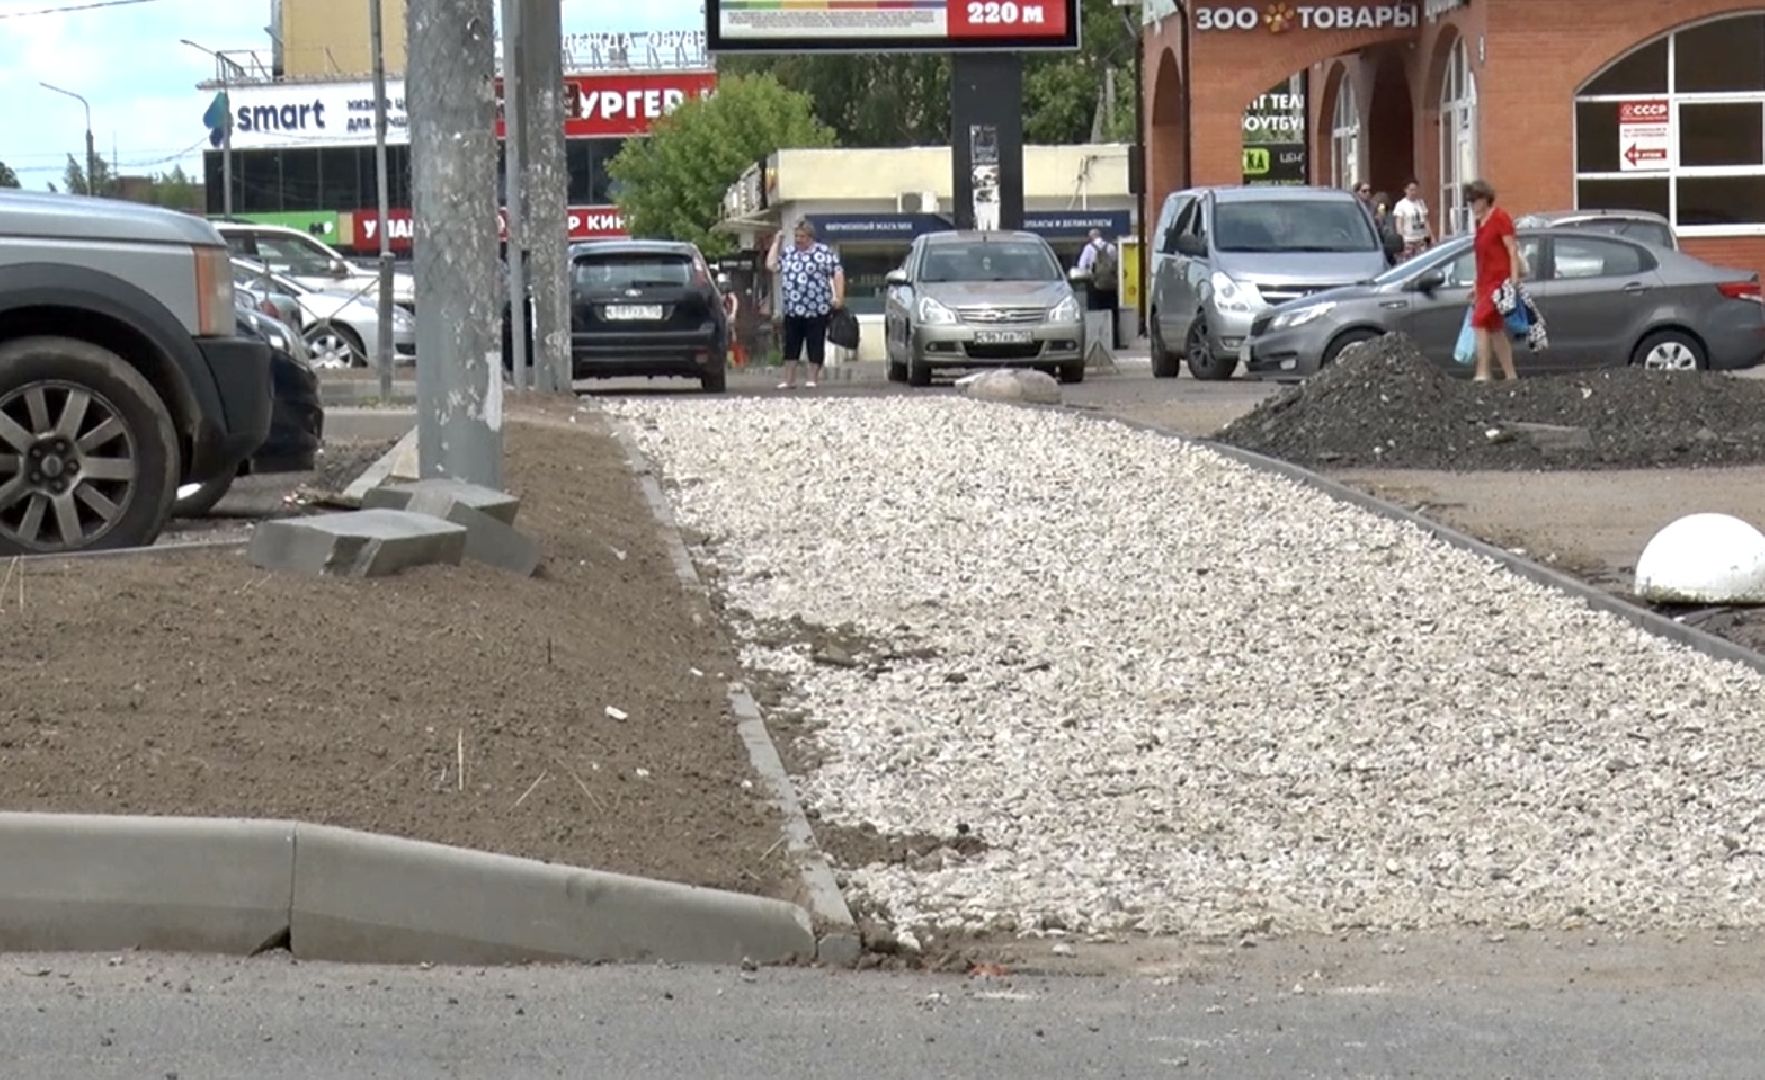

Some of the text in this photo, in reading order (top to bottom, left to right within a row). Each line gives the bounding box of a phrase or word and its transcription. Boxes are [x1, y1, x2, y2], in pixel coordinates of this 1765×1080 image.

[966, 2, 1019, 24] 220
[1196, 5, 1418, 30] ЗОО ТОВАРЫ
[237, 98, 325, 131] smart
[580, 90, 684, 118] УРГЕР
[1243, 116, 1305, 131] ОУТБУ
[1247, 151, 1266, 169] КА
